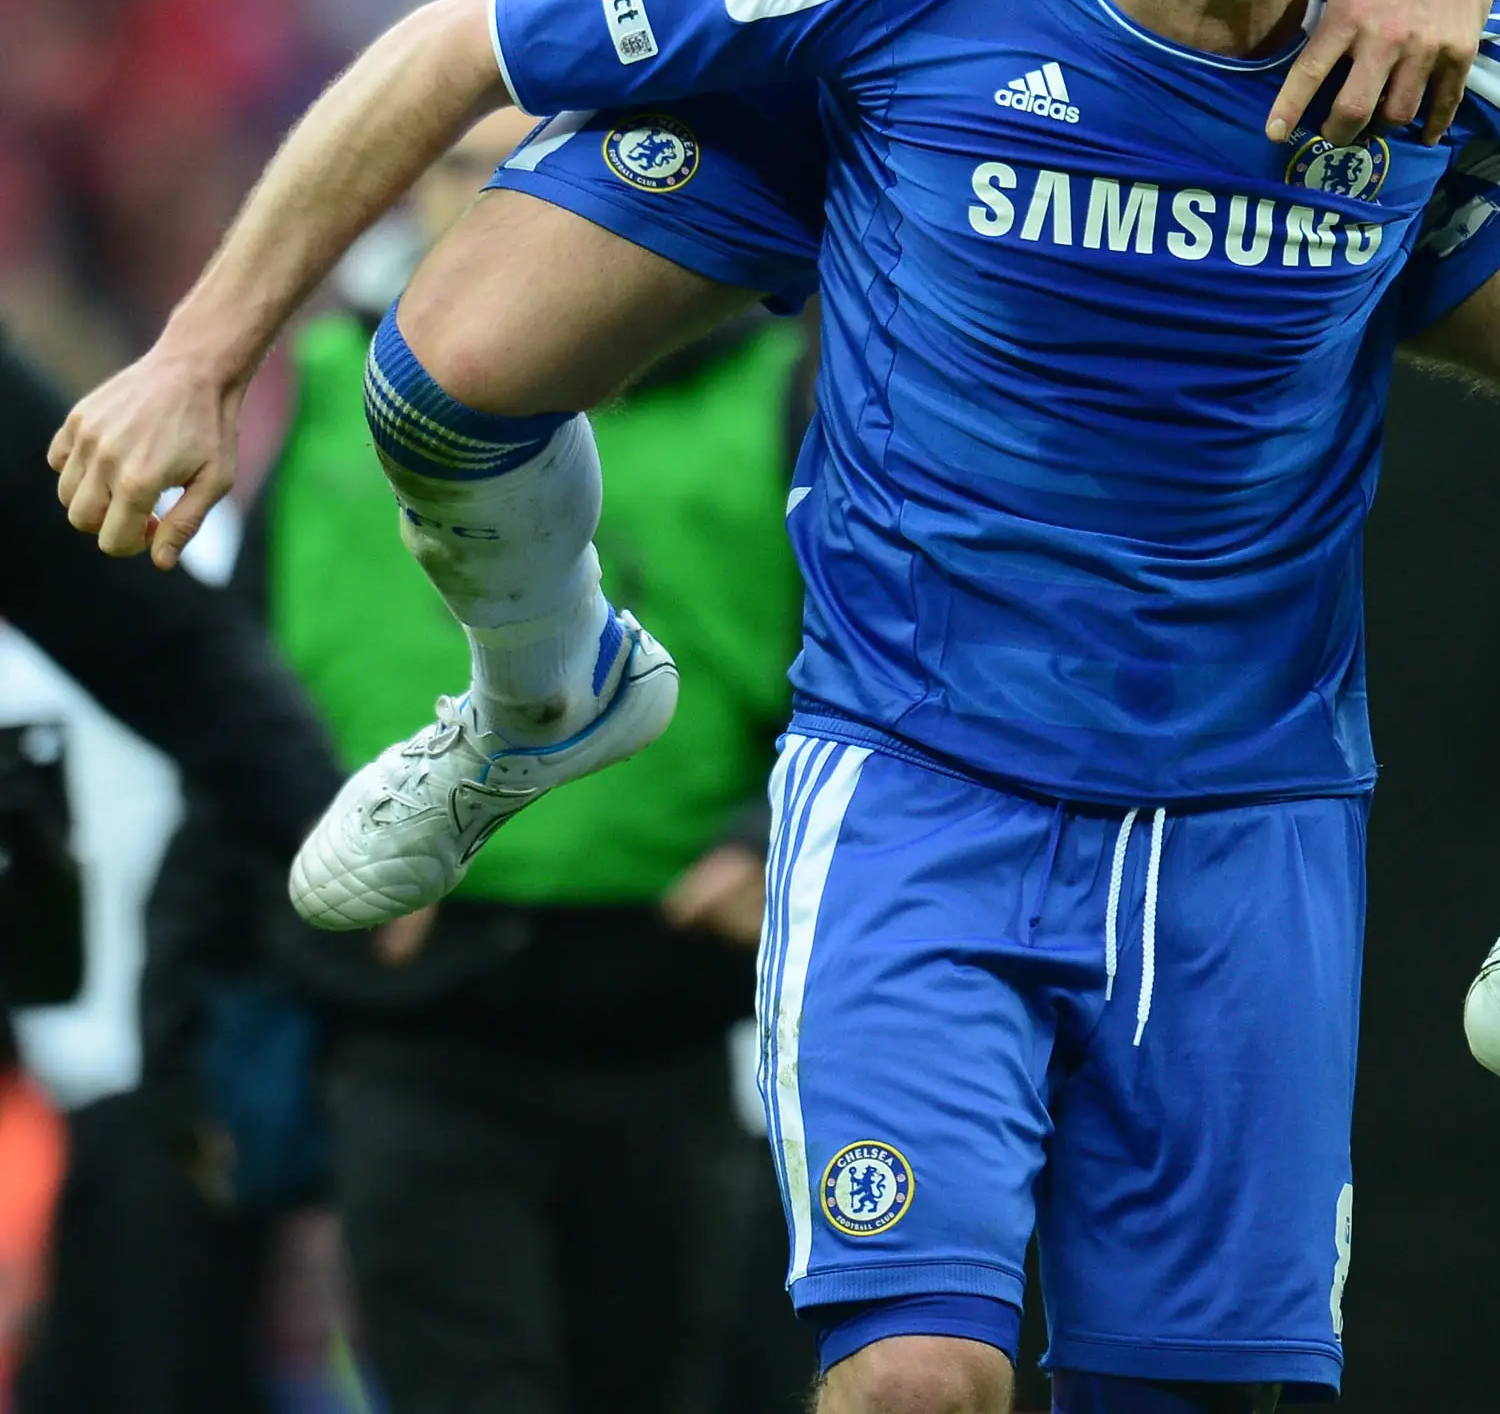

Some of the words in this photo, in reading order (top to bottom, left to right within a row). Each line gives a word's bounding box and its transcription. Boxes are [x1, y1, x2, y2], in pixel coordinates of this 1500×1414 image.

[994, 89, 1080, 124] adidas
[636, 177, 657, 187] CLUB
[968, 162, 1383, 267] SAMSUNG
[837, 1148, 894, 1168] CHELSEA
[836, 1215, 873, 1230] FOOTBALL
[875, 1212, 895, 1226] CLUB
